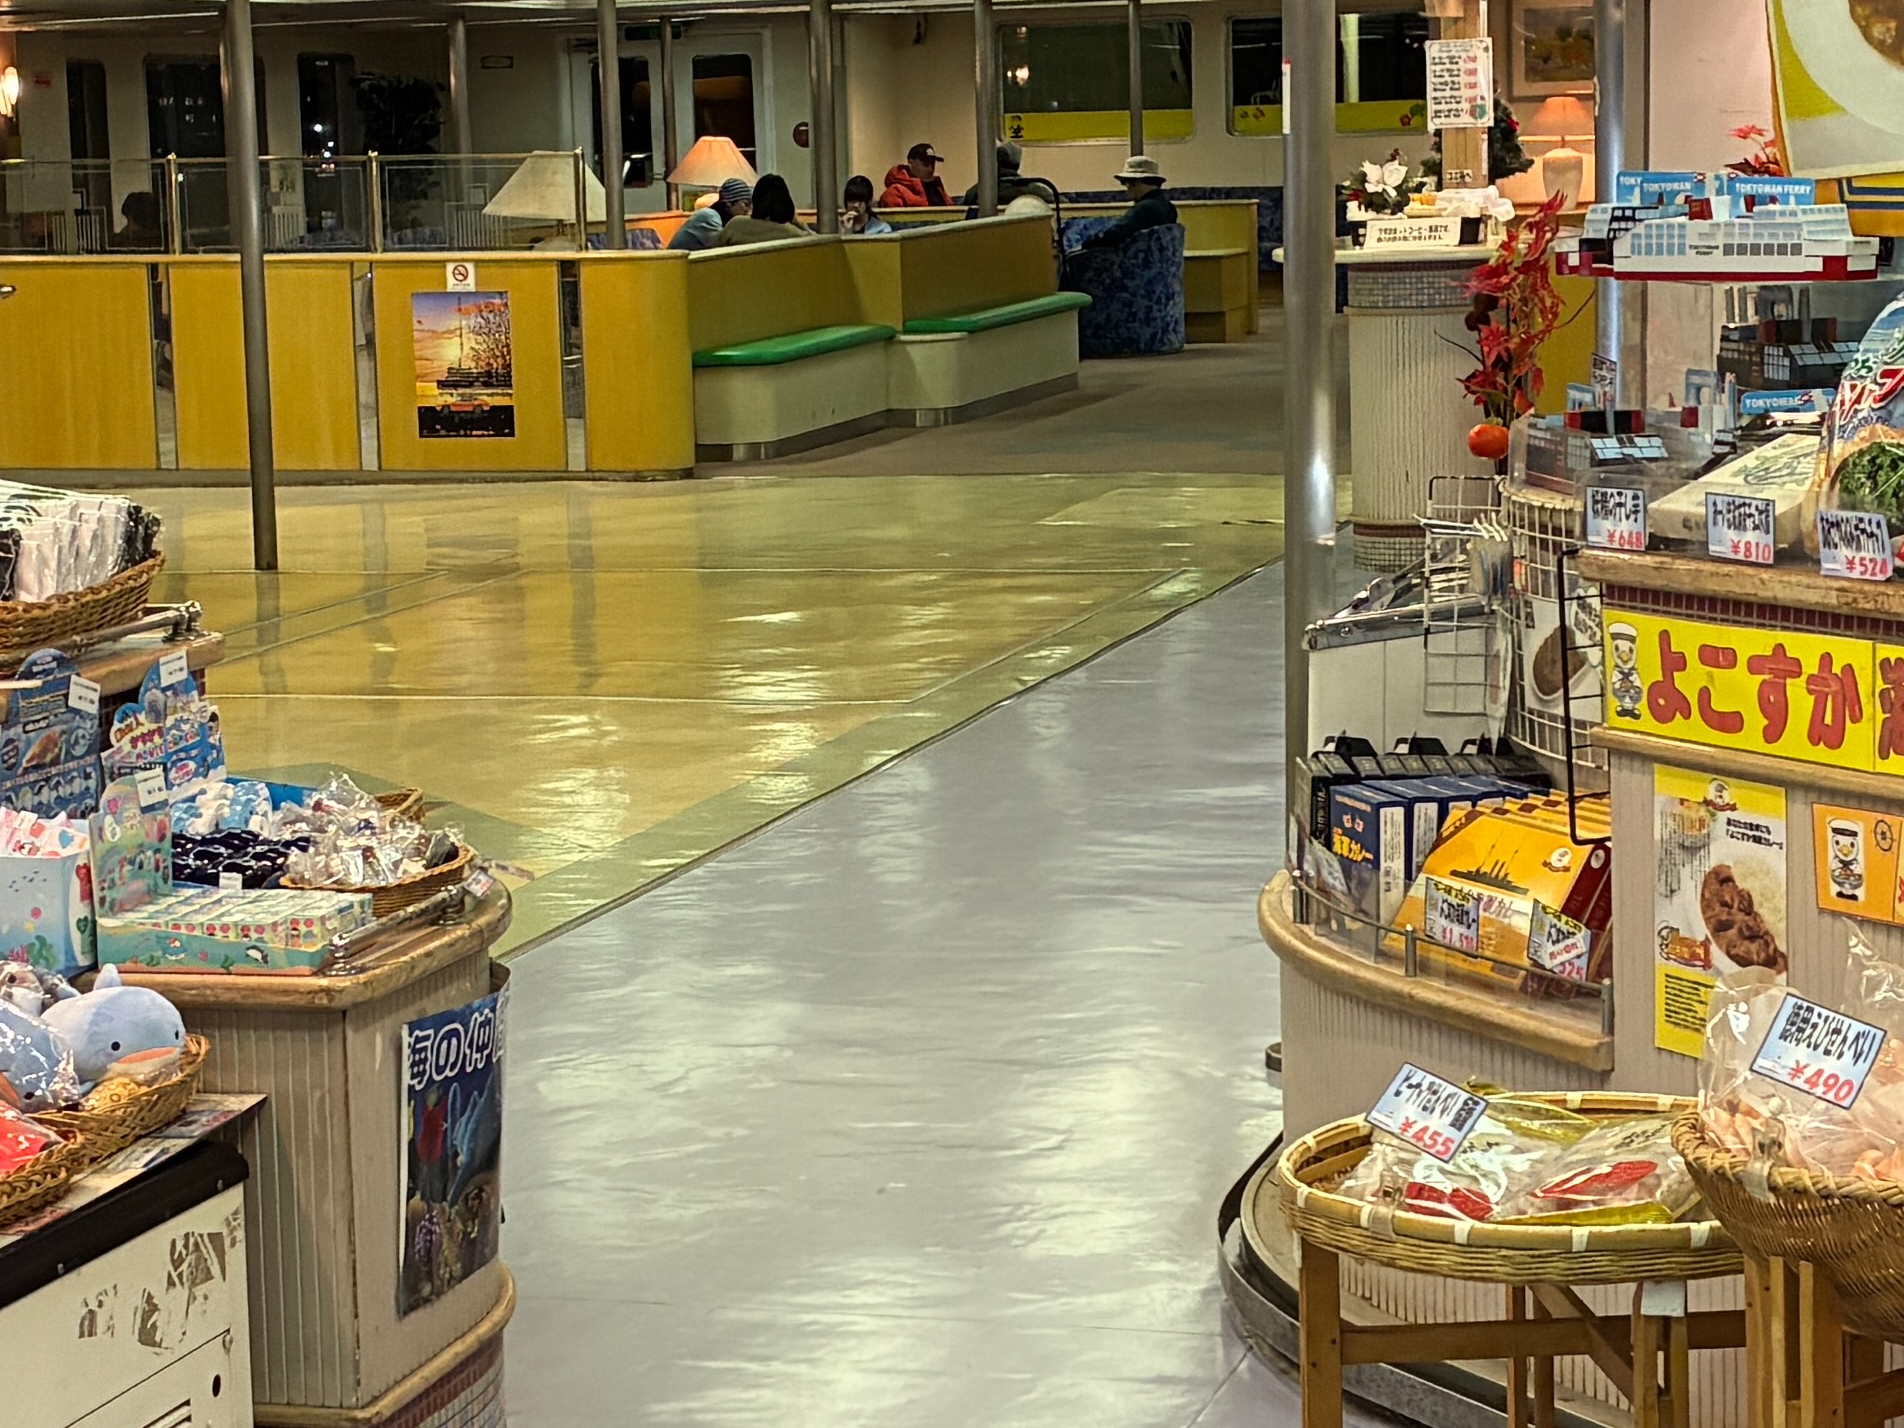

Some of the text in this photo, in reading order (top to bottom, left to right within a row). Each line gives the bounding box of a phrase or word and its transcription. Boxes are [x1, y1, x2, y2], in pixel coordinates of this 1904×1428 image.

[1606, 528, 1643, 550] ¥648
[1729, 538, 1772, 562] ¥810
[1845, 554, 1889, 578] ¥524
[1787, 1059, 1855, 1103] ¥490
[1398, 1116, 1455, 1156] ¥455
